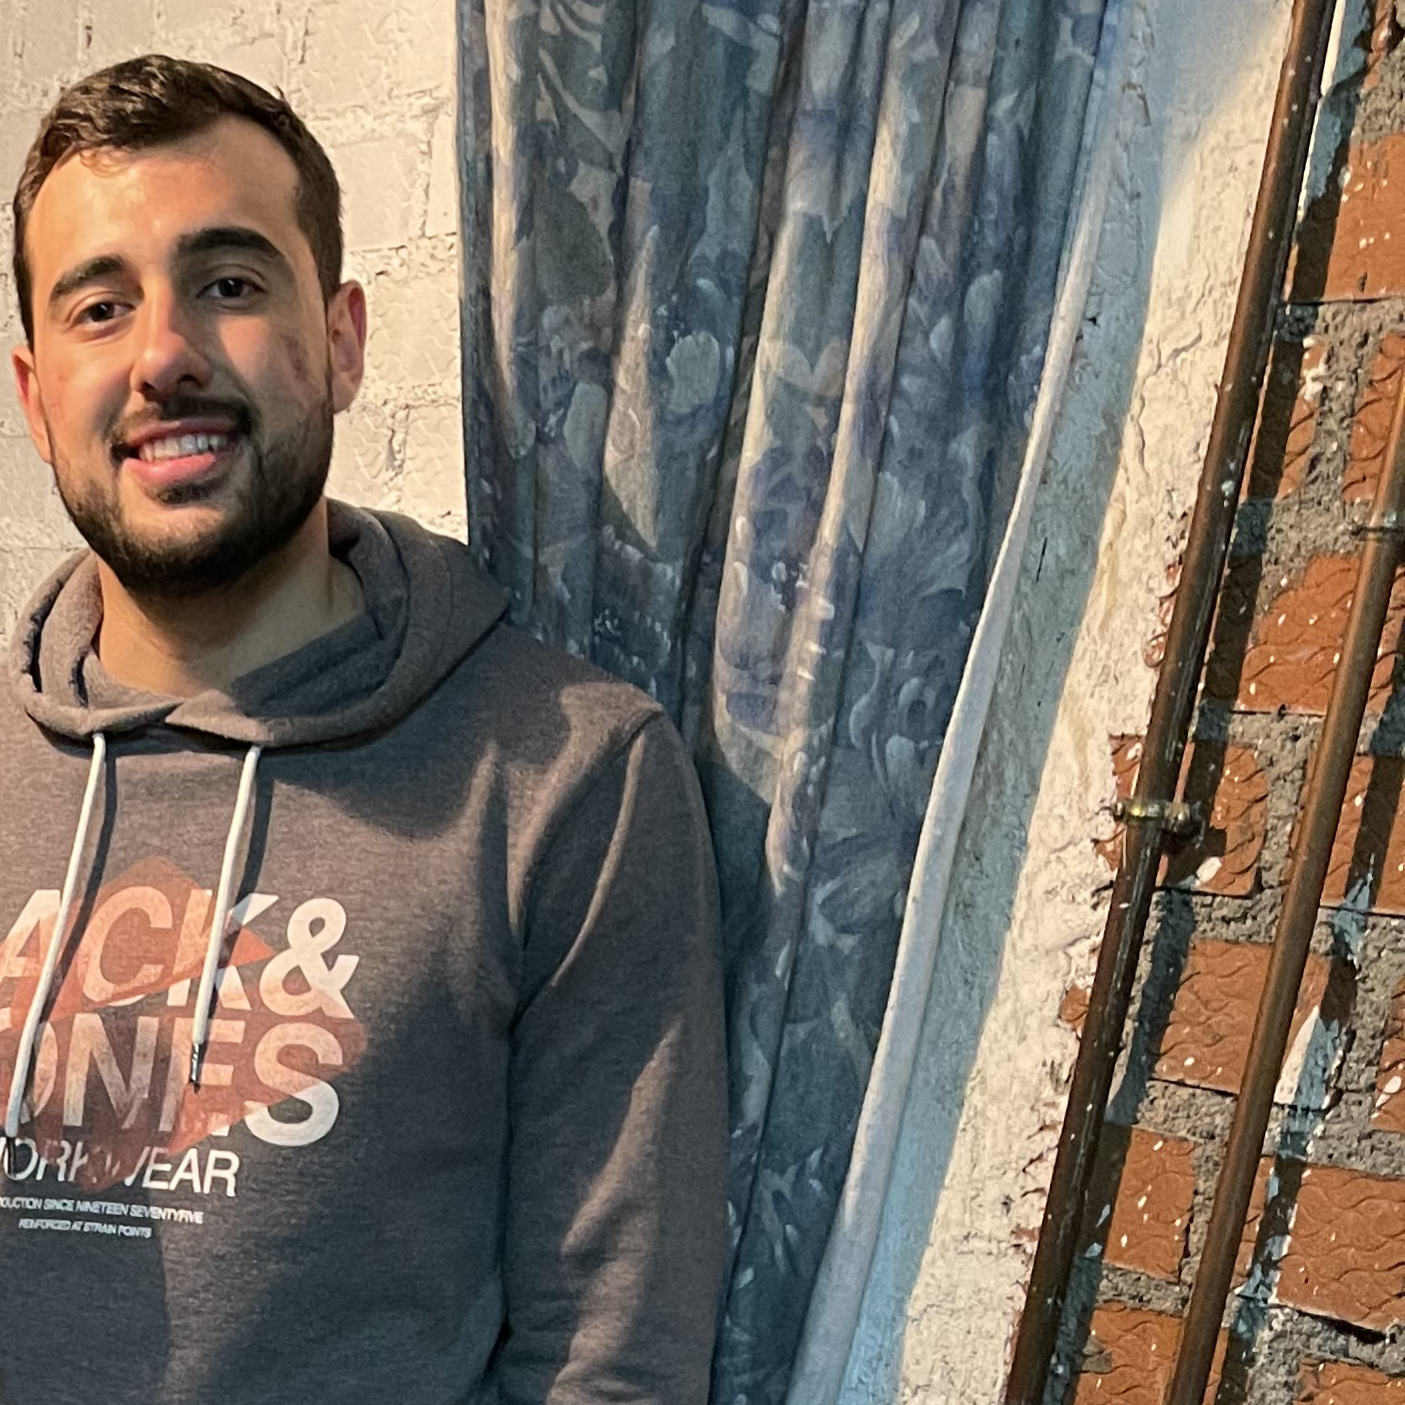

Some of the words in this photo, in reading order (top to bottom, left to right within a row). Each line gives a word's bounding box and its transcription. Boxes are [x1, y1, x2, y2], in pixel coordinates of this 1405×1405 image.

[43, 1199, 75, 1212] SINCE
[76, 1200, 129, 1216] NINETEEN
[130, 1205, 205, 1225] SEVENTYFIVE
[71, 1220, 84, 1232] AT
[118, 1224, 152, 1239] POINTS
